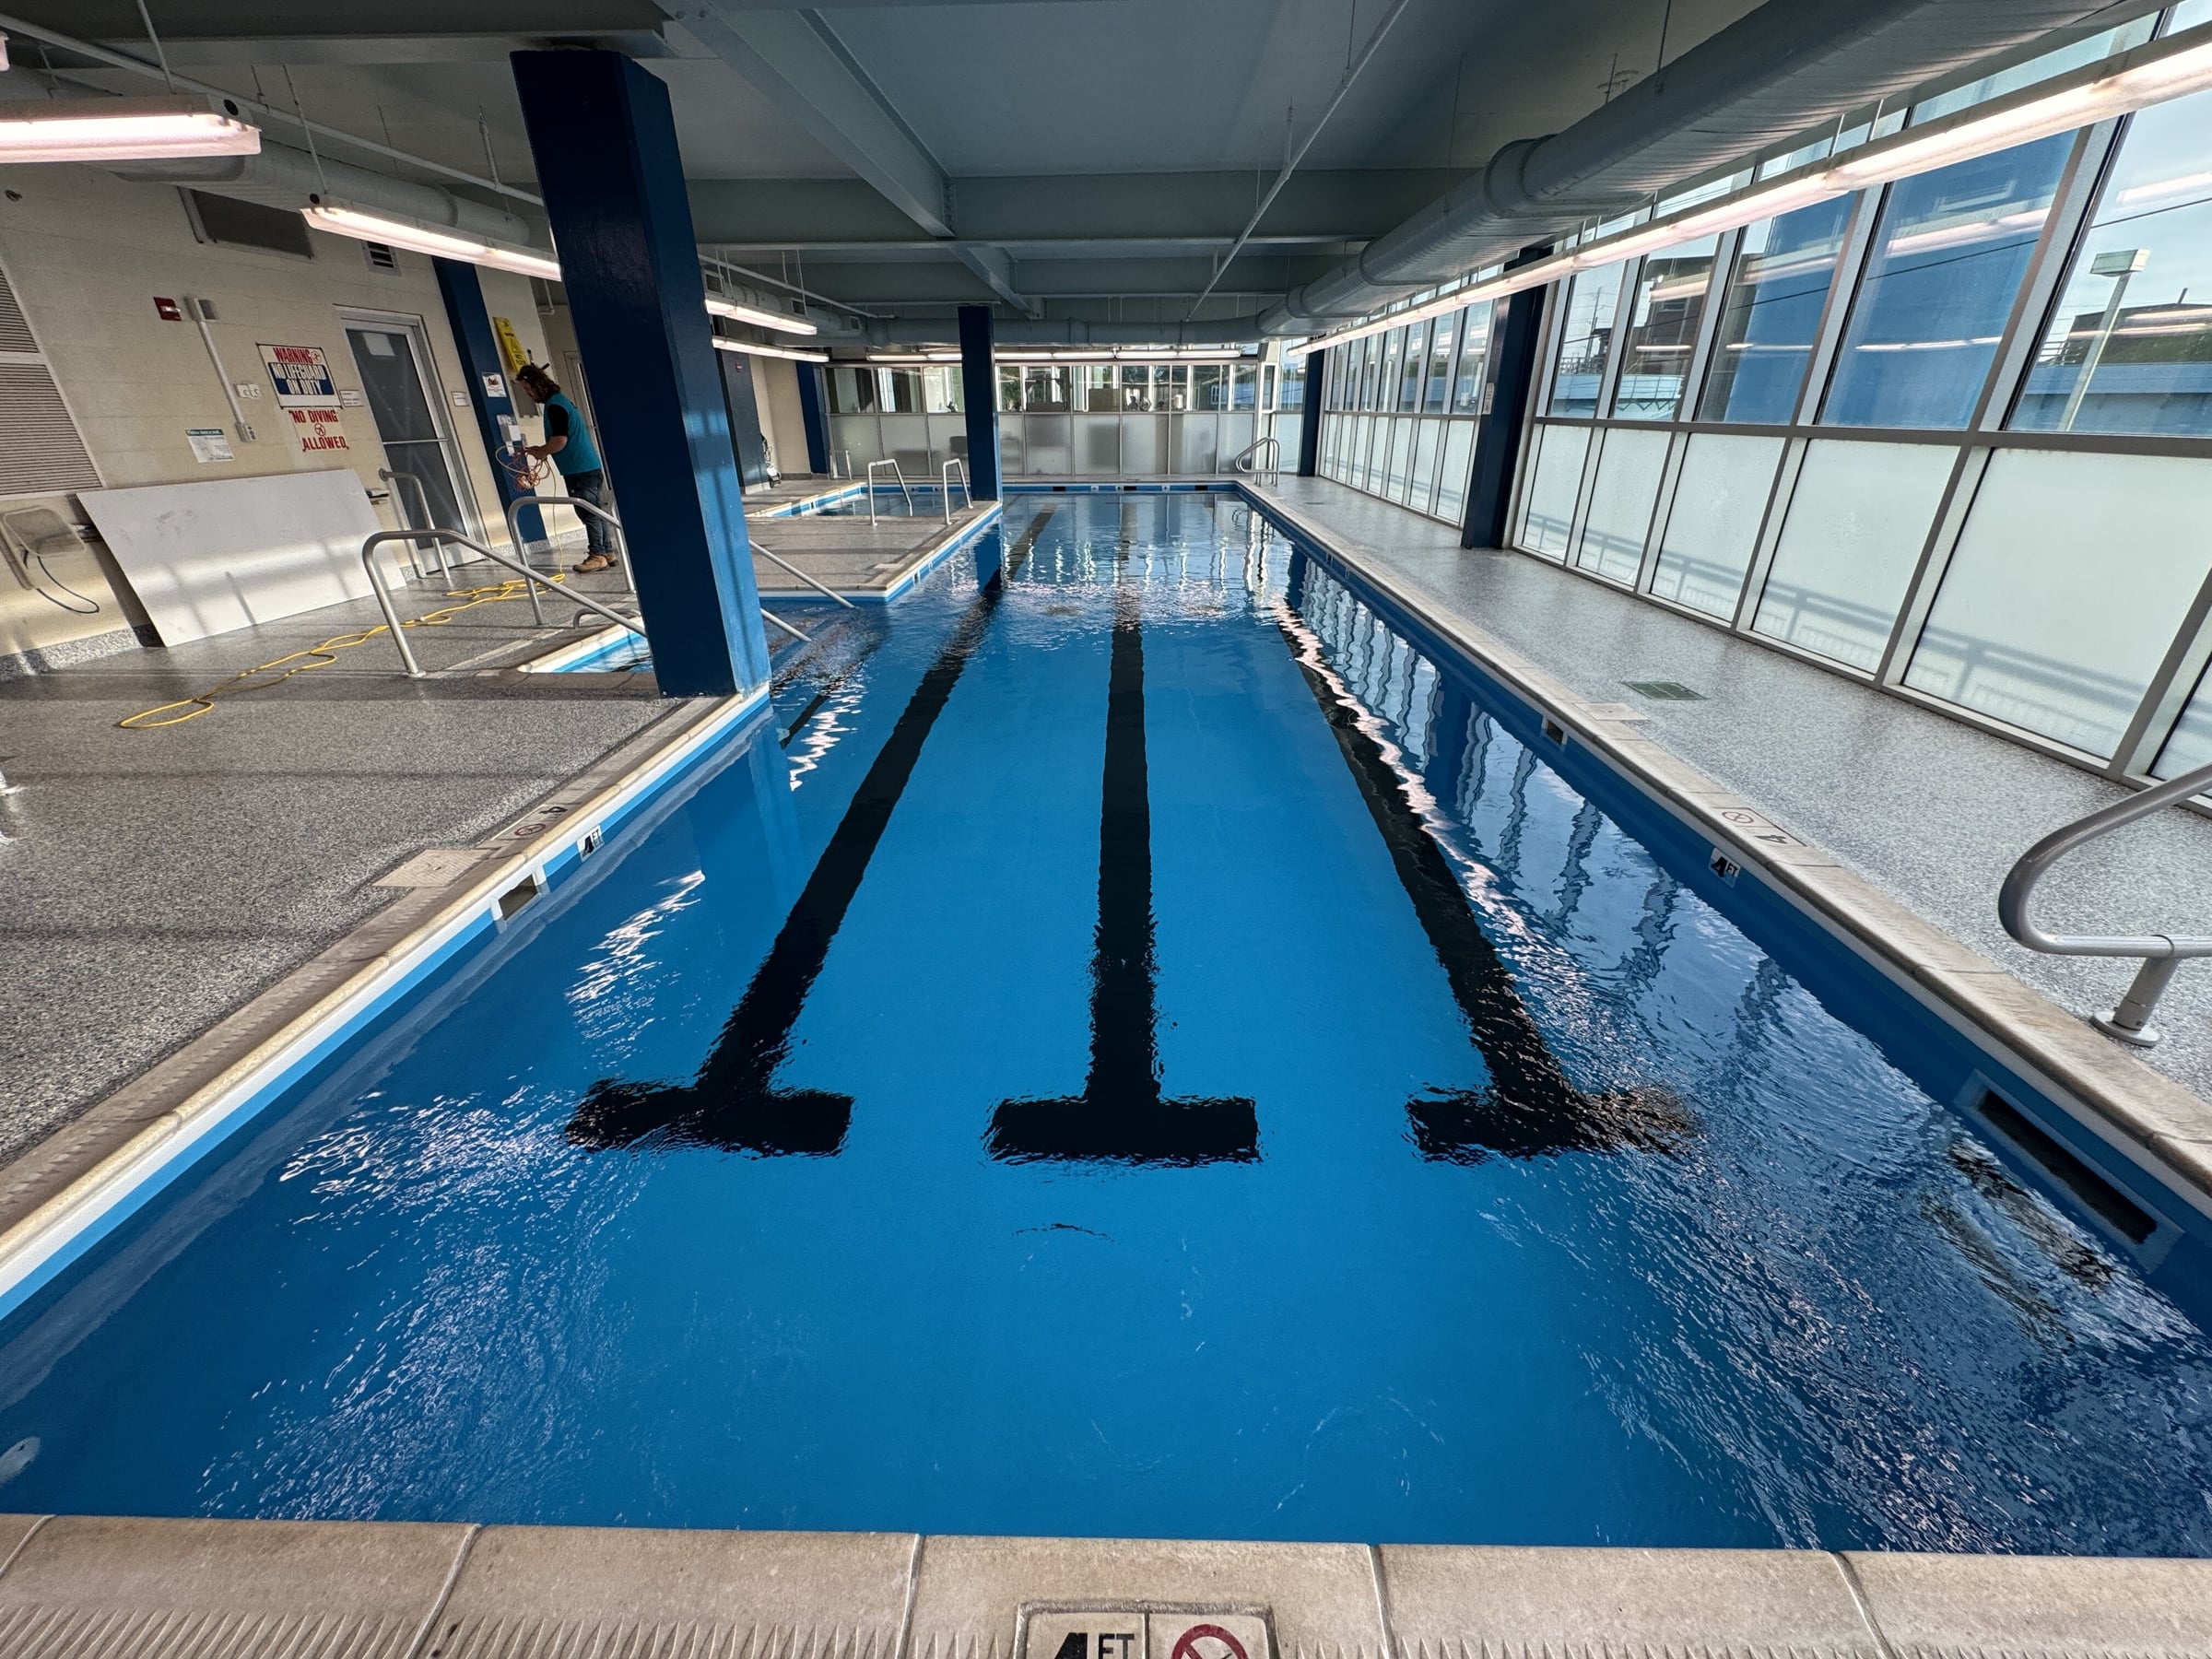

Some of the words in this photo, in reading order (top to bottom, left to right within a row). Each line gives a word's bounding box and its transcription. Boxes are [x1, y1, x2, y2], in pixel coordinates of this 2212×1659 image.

[273, 347, 313, 364] WARNING
[270, 362, 287, 380] NO
[285, 363, 326, 381] LIFEGUARD
[286, 379, 301, 394] ON
[300, 379, 323, 395] DUTY
[291, 410, 306, 423] NO
[308, 410, 338, 423] DIVING
[301, 436, 347, 451] ALLOWED
